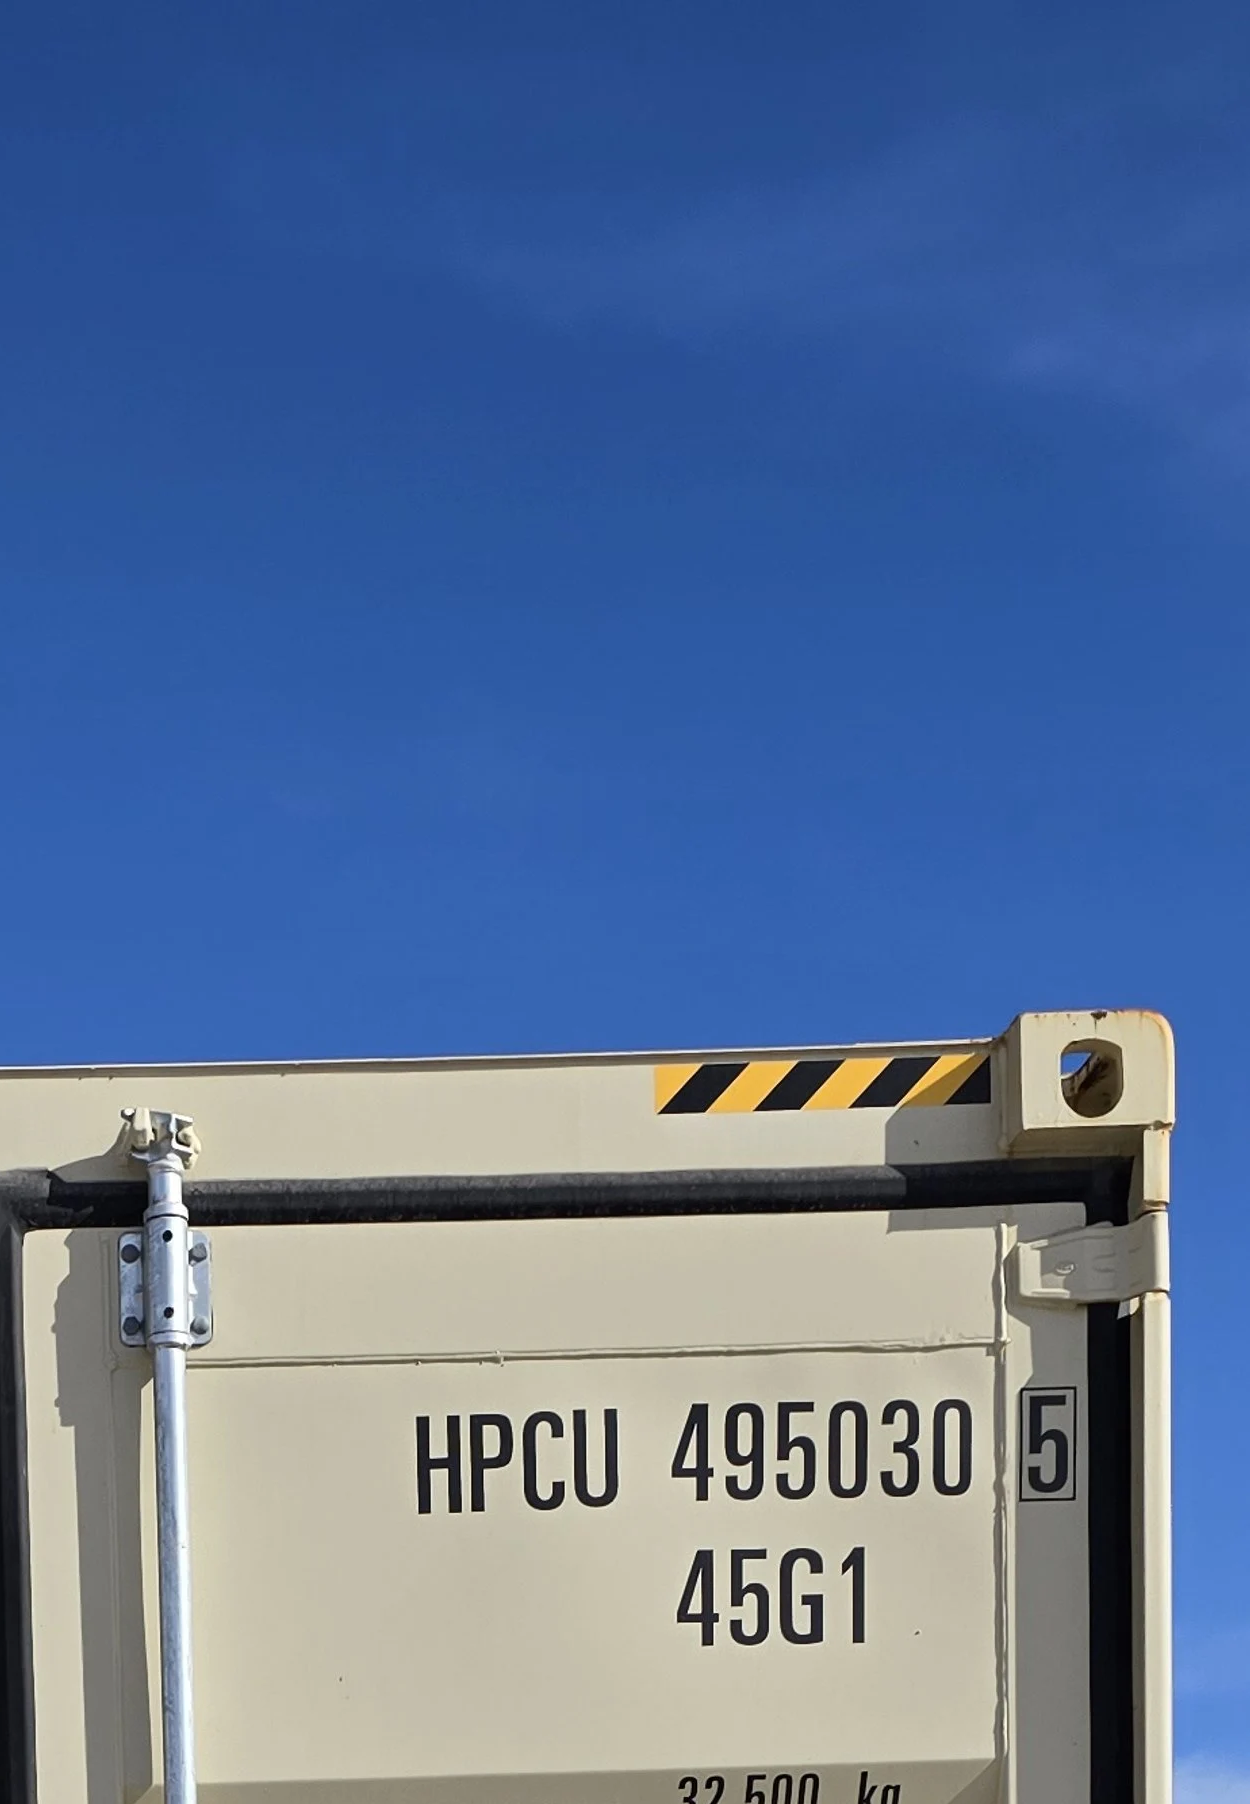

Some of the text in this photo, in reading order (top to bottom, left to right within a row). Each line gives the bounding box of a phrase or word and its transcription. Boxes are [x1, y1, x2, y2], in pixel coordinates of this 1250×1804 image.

[415, 1394, 1071, 1515] HPCU 495030 5
[676, 1546, 866, 1647] 45G1
